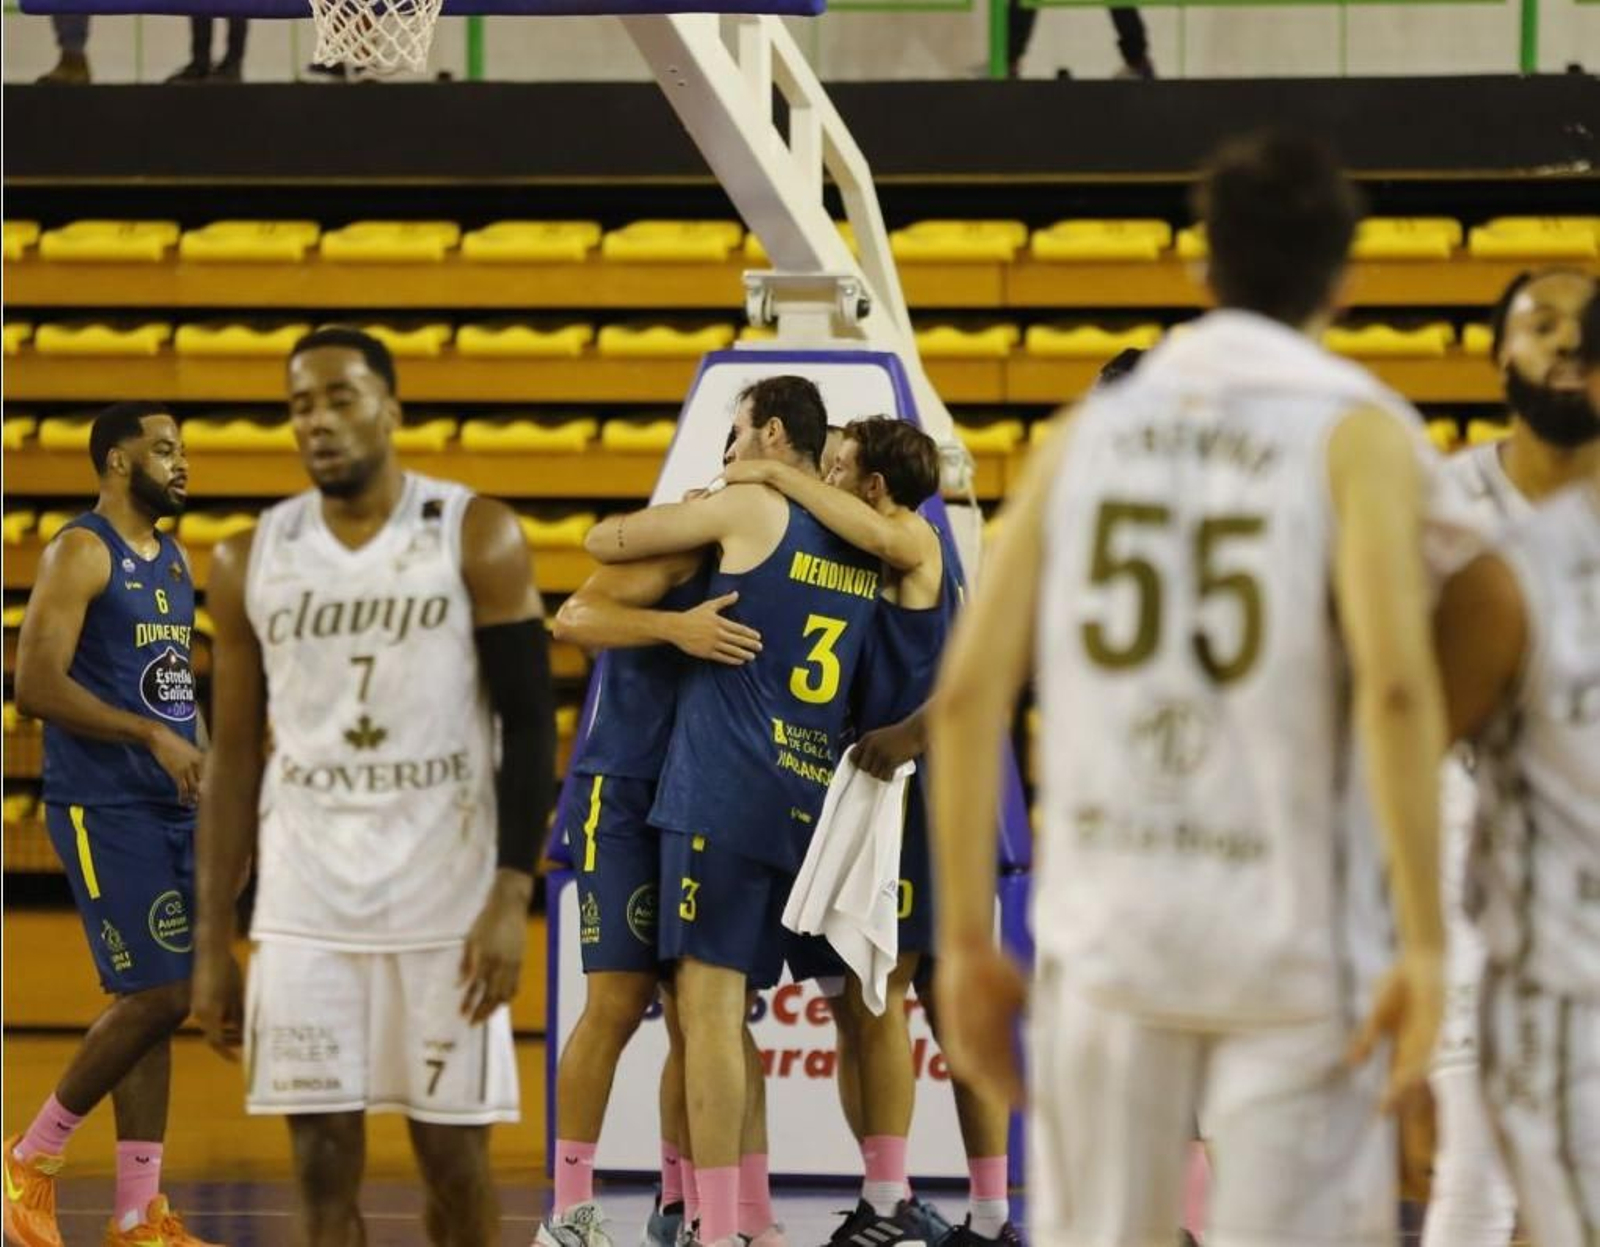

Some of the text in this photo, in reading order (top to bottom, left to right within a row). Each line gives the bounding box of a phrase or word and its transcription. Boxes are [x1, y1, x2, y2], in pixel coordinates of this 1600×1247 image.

[789, 551, 879, 600] MENDIKOTE
[1080, 499, 1268, 688] 55
[155, 588, 169, 614] 6
[267, 590, 453, 646] clavijo
[349, 655, 376, 705] 7
[789, 613, 848, 704] 3
[786, 724, 829, 744] XUNTA
[678, 877, 700, 922] 3
[425, 1059, 447, 1097] 7
